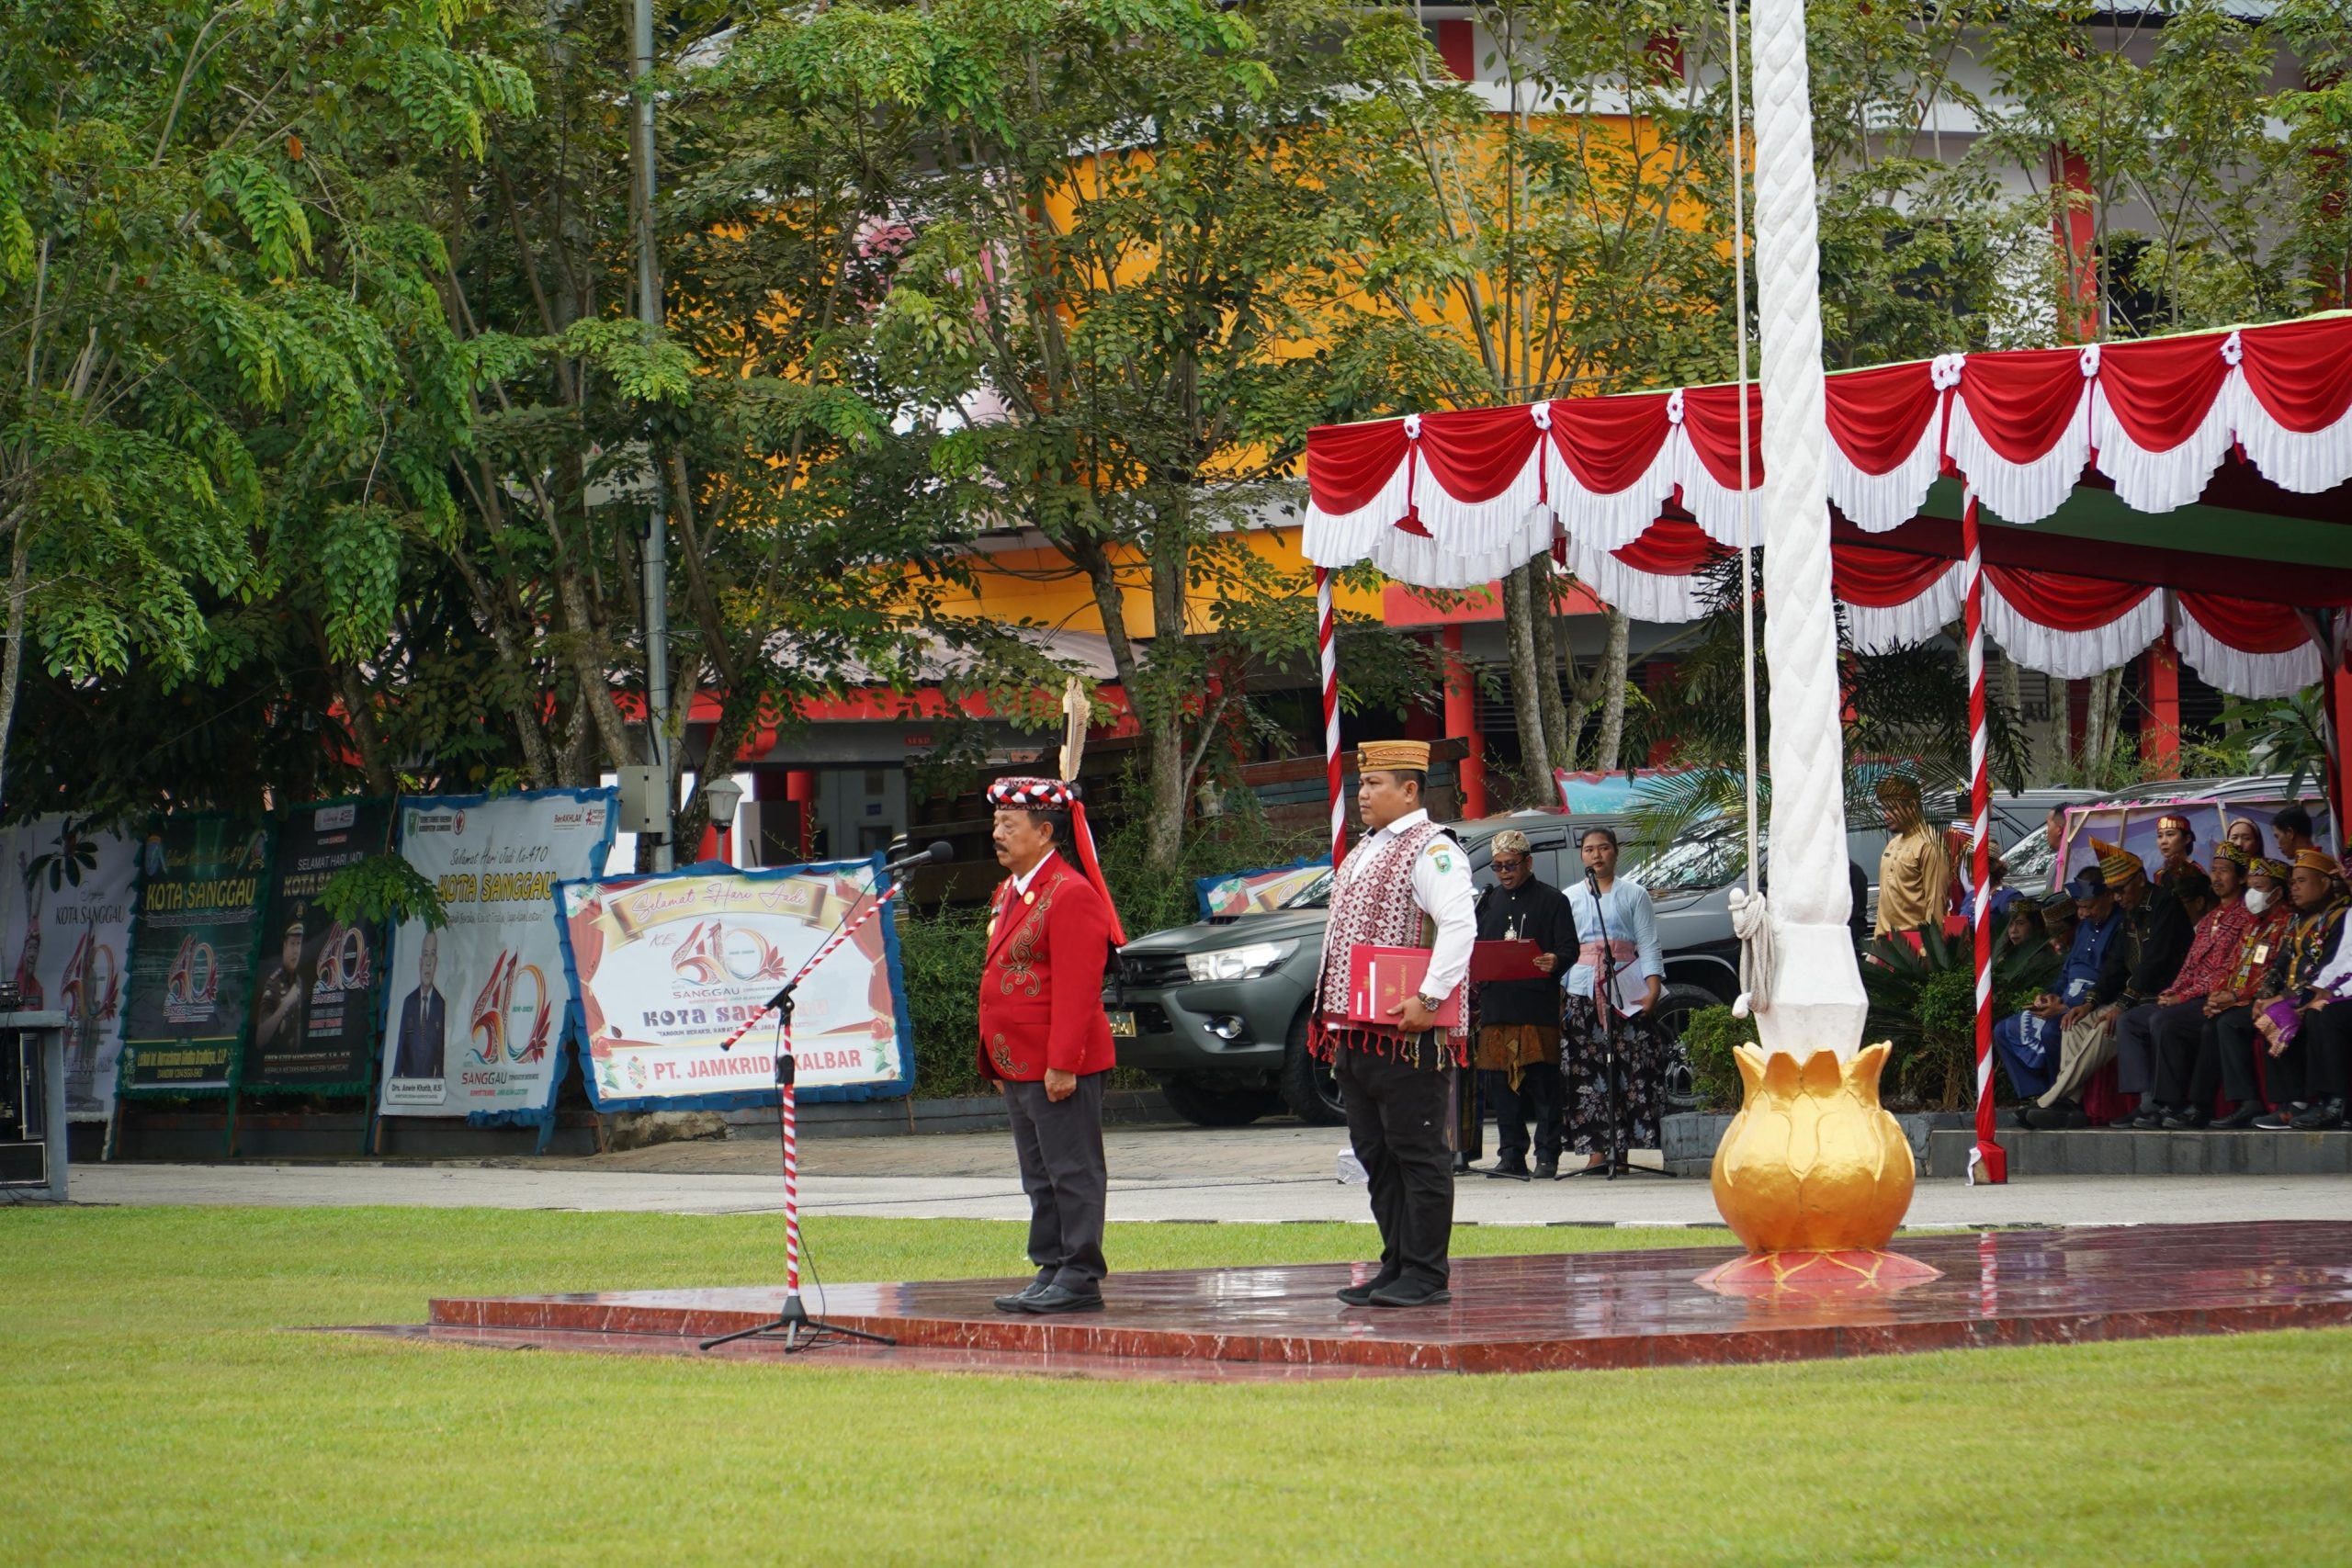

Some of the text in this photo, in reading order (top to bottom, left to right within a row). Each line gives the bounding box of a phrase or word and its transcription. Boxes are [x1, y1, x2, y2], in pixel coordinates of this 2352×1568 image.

[297, 856, 330, 872] SELAMAT
[330, 853, 347, 868] HARI
[450, 845, 548, 865] Selamat Hari Jadi Ke-410
[146, 878, 256, 911] KOTA SANGGAU
[283, 873, 315, 897] KOTA
[437, 871, 556, 903] KOTA SANGGAU
[632, 879, 809, 921] Selamat Hari Jadi
[56, 906, 78, 925] KOTA
[80, 905, 125, 924] SANGGAU
[650, 931, 679, 947] KE
[673, 987, 741, 999] SANGGAU
[654, 1061, 681, 1080] PT.
[794, 1049, 862, 1072] KALBAR
[391, 1084, 401, 1092] Drs.
[461, 1071, 508, 1085] SANGGAU
